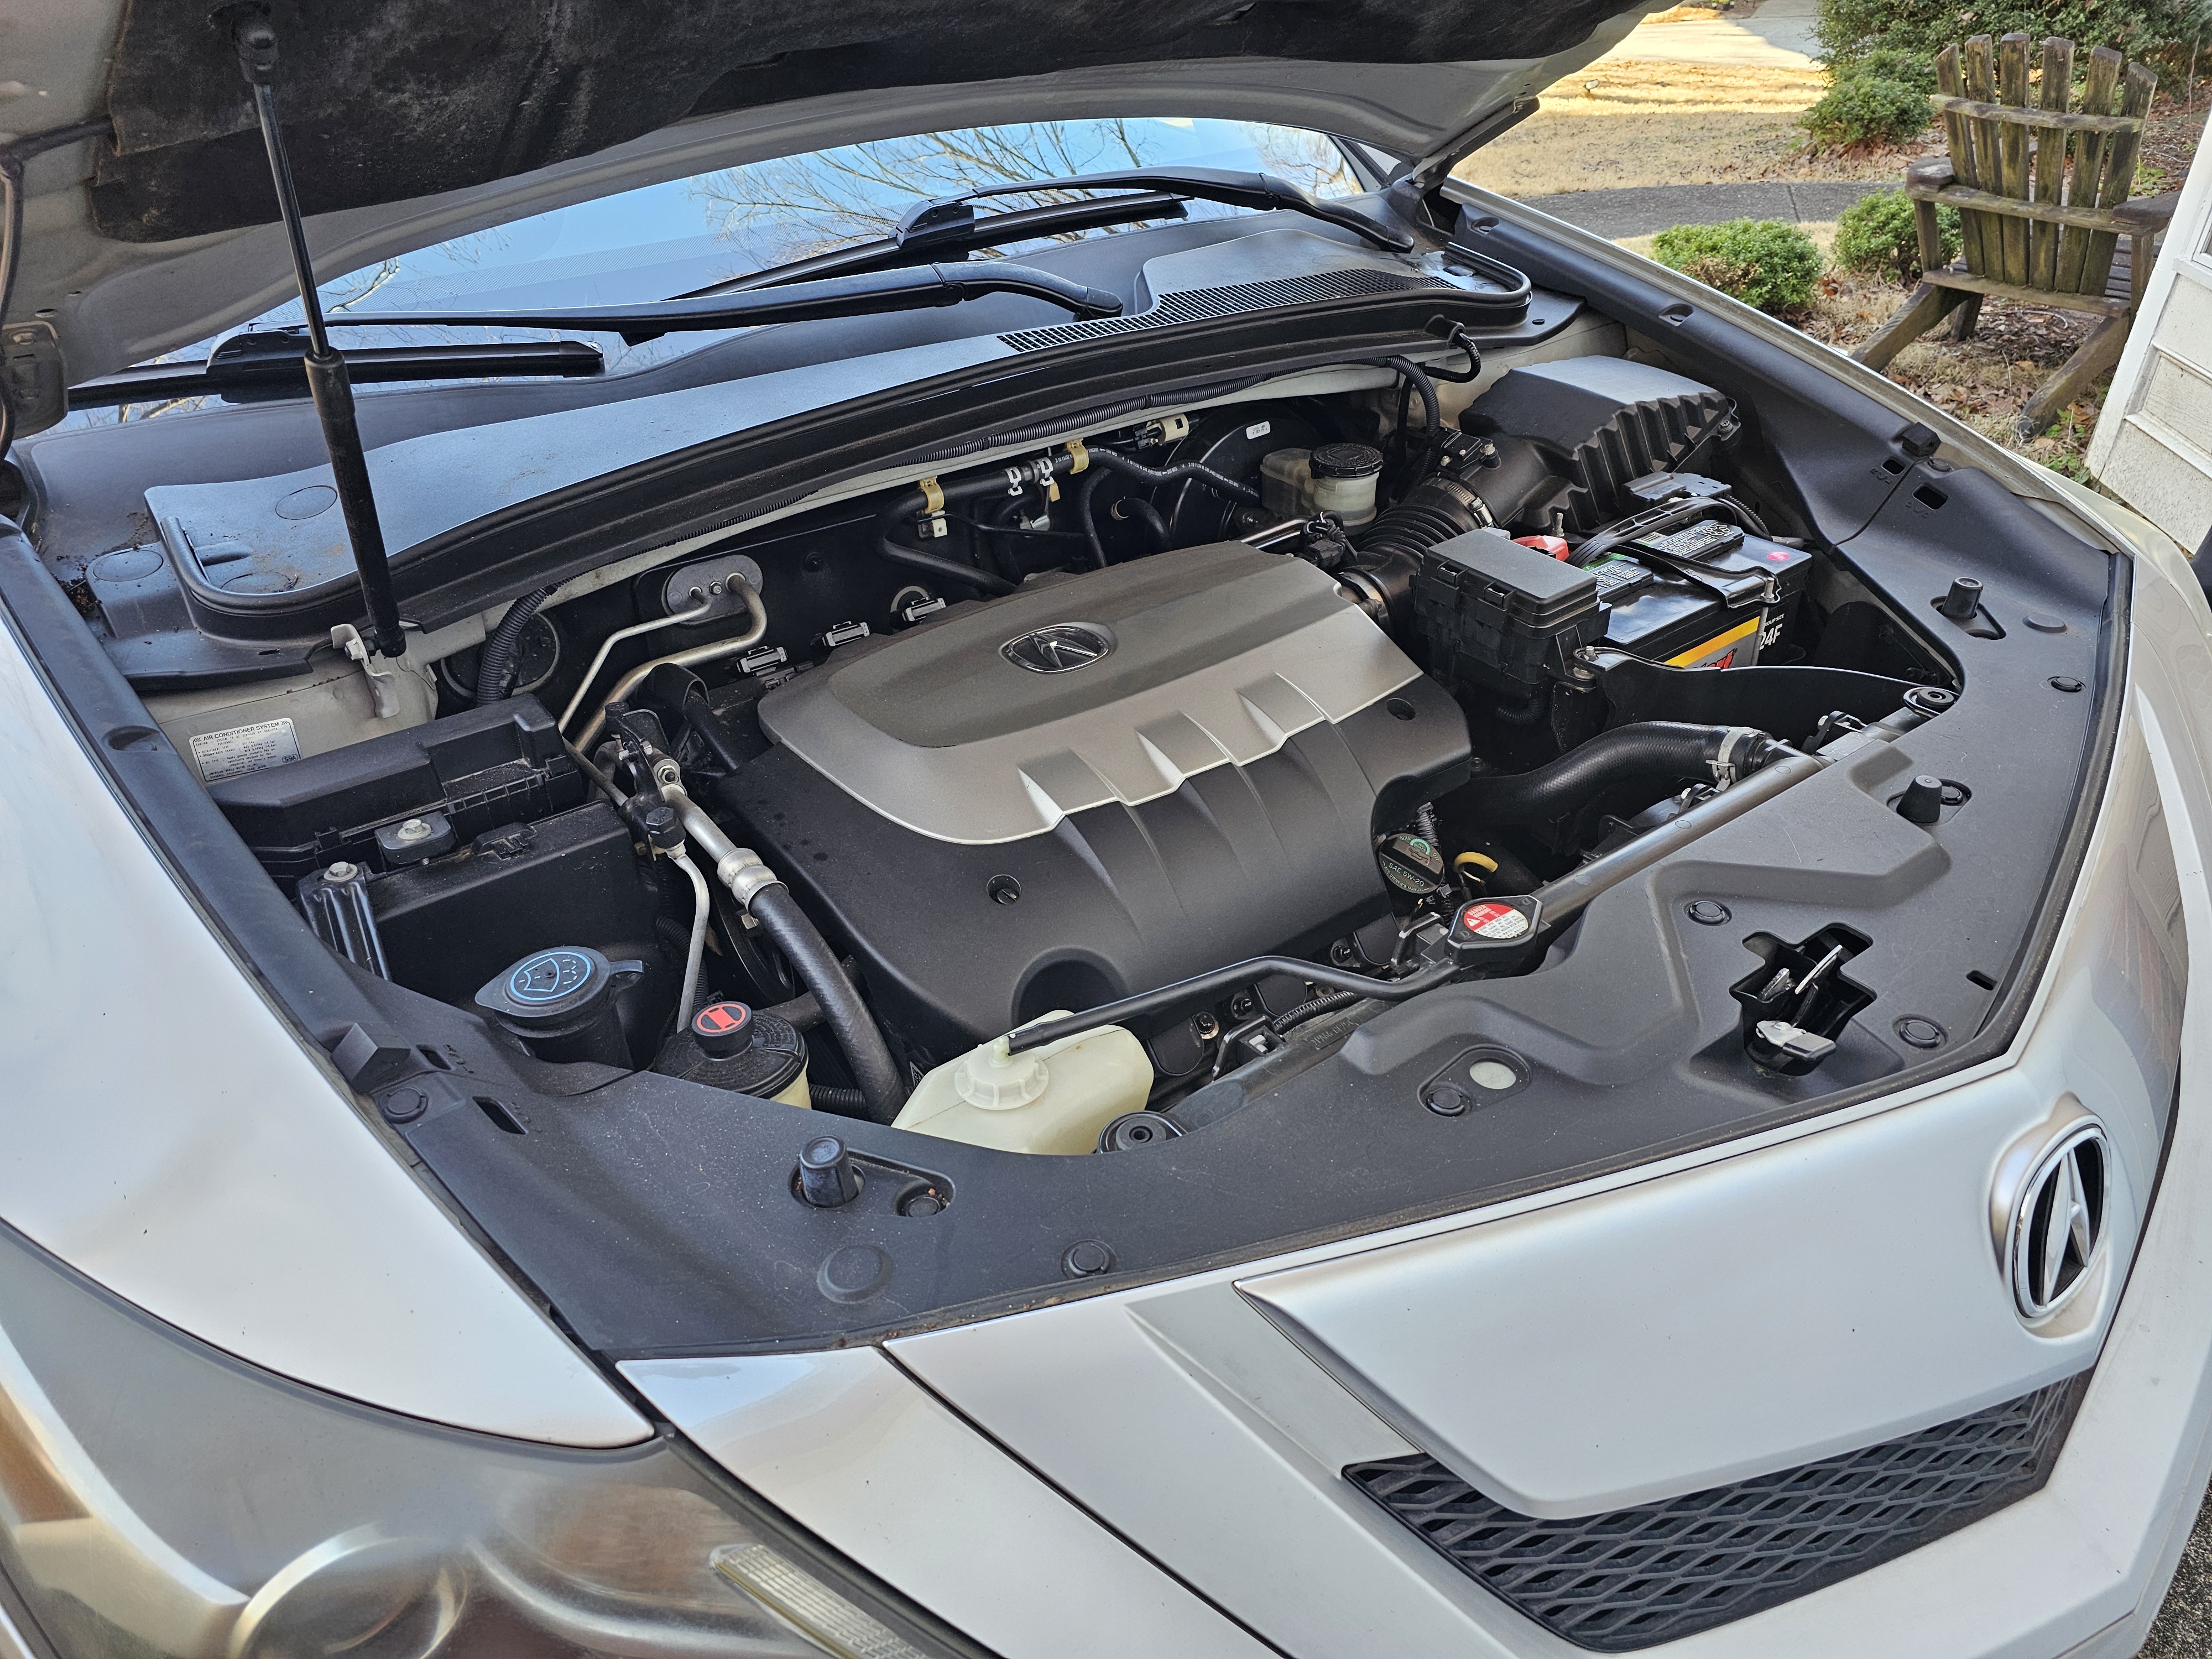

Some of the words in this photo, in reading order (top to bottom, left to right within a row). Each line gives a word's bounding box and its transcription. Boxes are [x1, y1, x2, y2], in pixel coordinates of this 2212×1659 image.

[1760, 623, 1782, 650] 24F
[215, 727, 255, 738] CONDITIONER
[256, 722, 279, 731] SYSTEM
[1389, 863, 1402, 873] SAE
[1402, 871, 1424, 886] 5W-20
